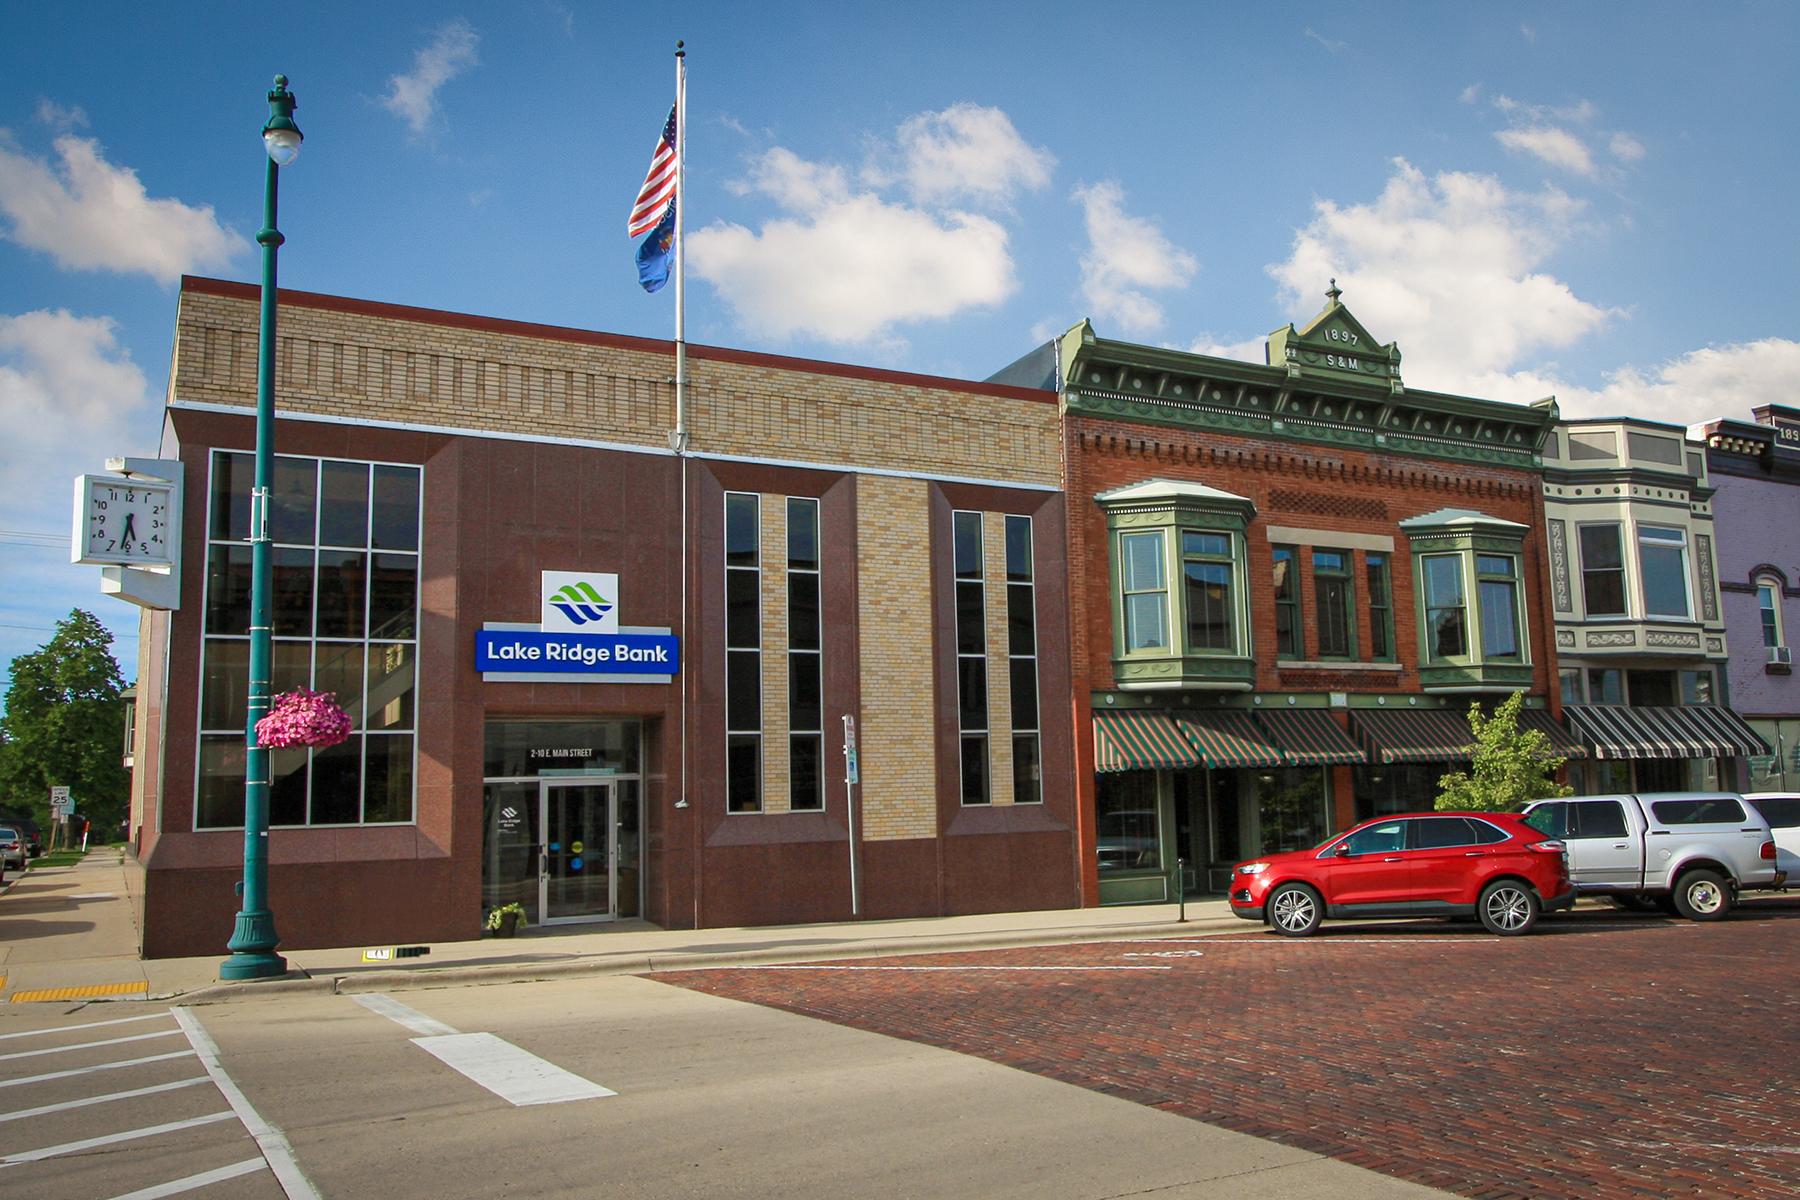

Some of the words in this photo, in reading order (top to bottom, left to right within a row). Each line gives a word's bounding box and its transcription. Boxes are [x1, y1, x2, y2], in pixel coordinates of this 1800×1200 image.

[1324, 328, 1358, 346] 1897
[110, 491, 117, 501] 11
[125, 492, 135, 503] 12
[97, 500, 108, 511] 10
[152, 505, 159, 515] 2
[98, 514, 106, 525] 9
[152, 519, 159, 529] 3
[97, 529, 105, 539] 8
[151, 534, 158, 543] 4
[109, 539, 116, 550] 7
[124, 540, 132, 550] 6
[140, 542, 147, 551] 5
[487, 641, 541, 660] Lake
[545, 642, 611, 666] Ridge
[614, 644, 668, 663] Bank
[530, 748, 545, 758] 2-10
[552, 748, 569, 758] MAIN
[569, 748, 593, 758] STREET
[53, 795, 68, 804] 25
